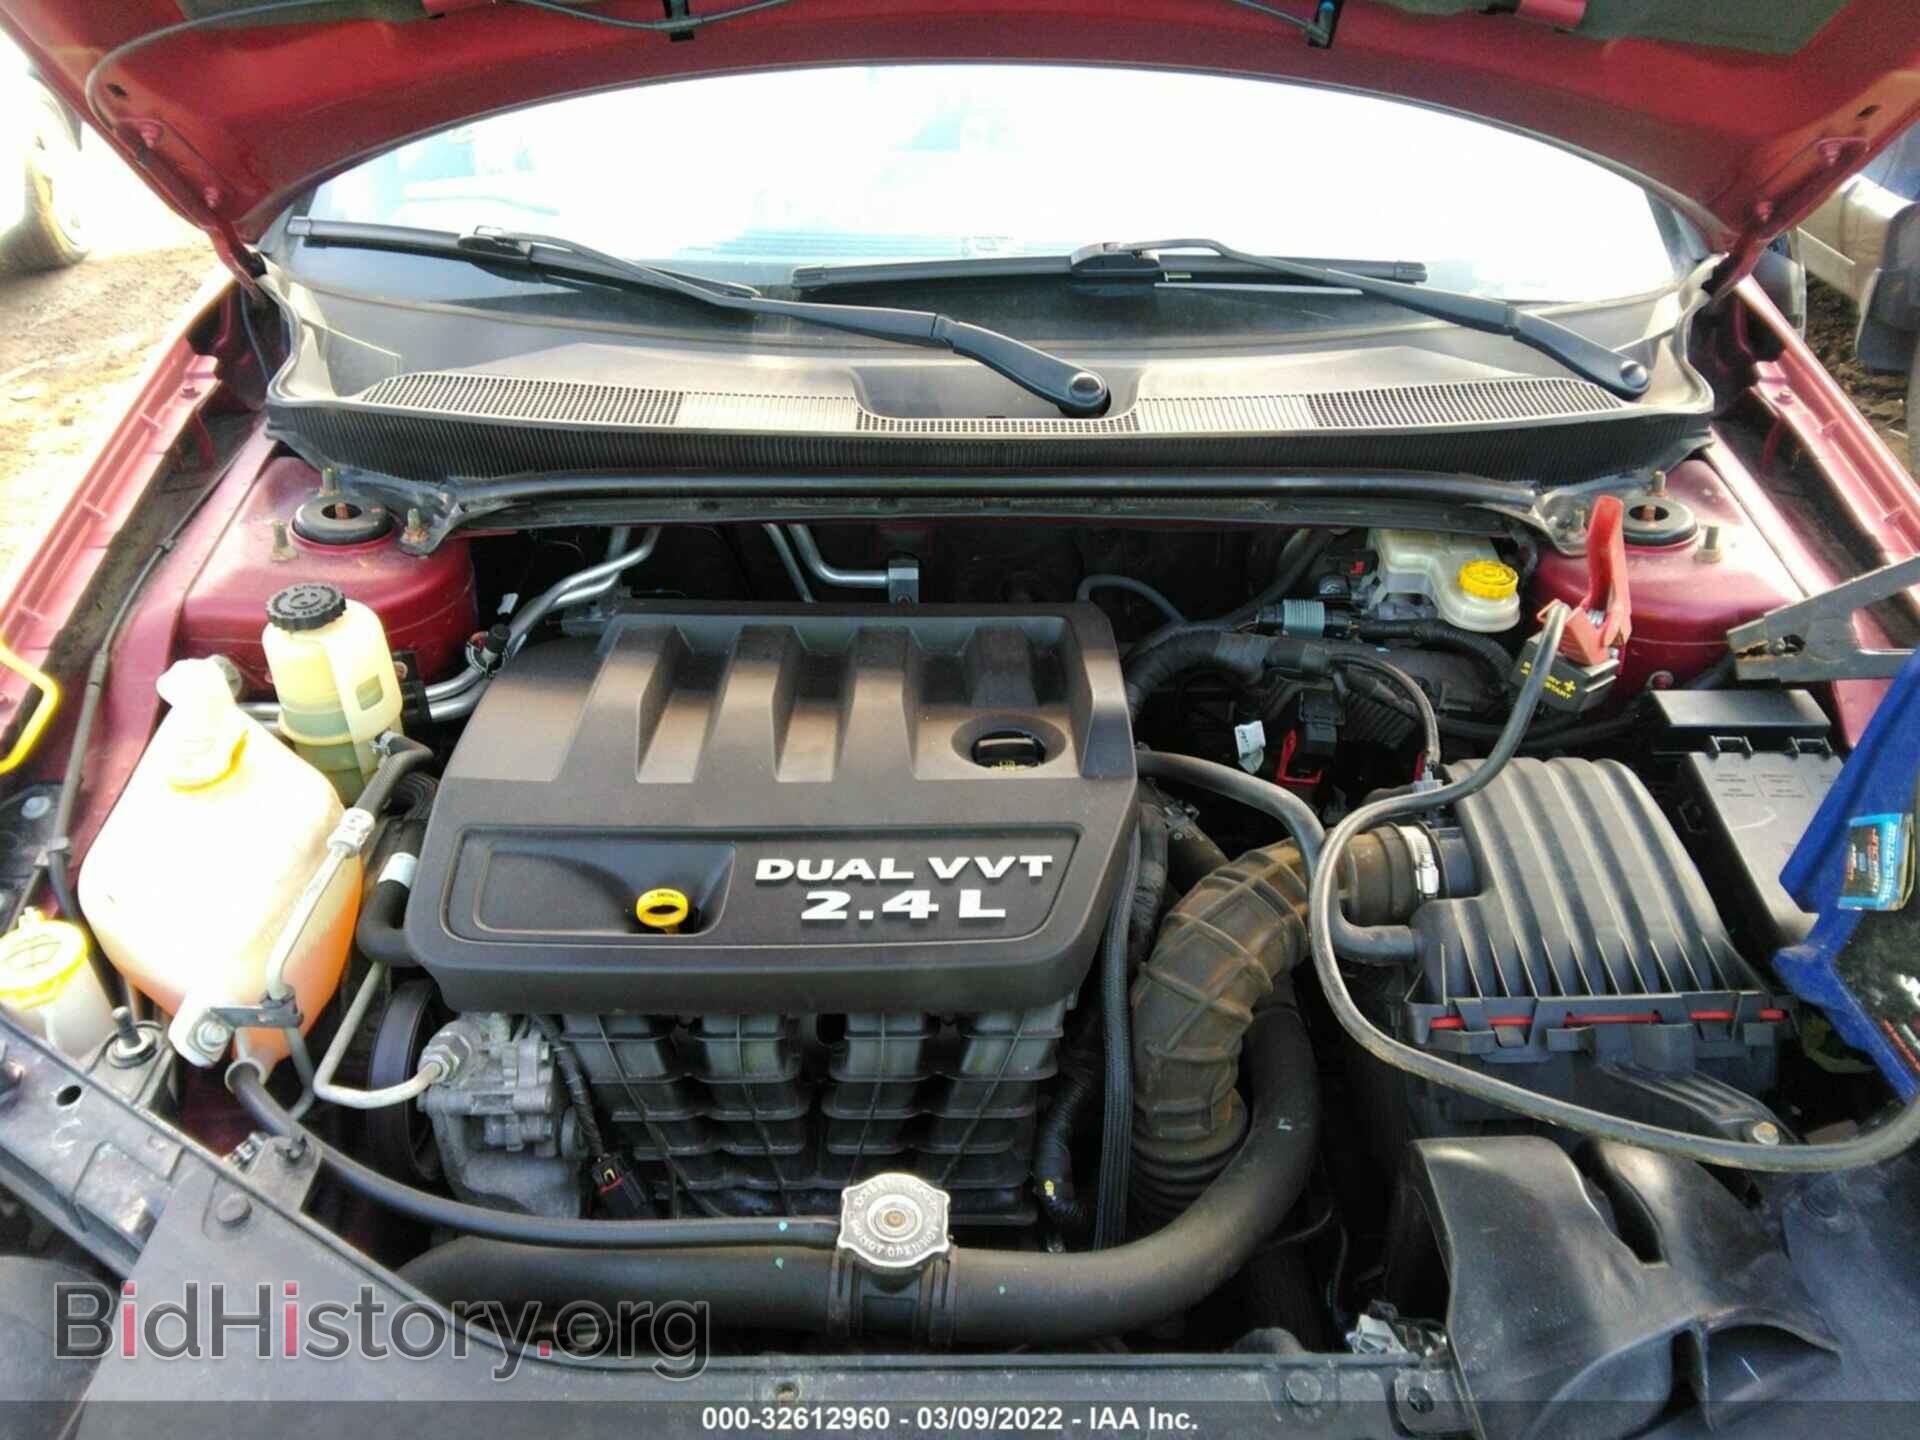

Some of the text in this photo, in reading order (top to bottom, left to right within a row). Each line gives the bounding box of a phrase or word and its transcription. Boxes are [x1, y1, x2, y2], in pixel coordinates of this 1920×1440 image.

[755, 855, 1053, 881] DUAL VVT
[801, 888, 1006, 920] 2.4 L
